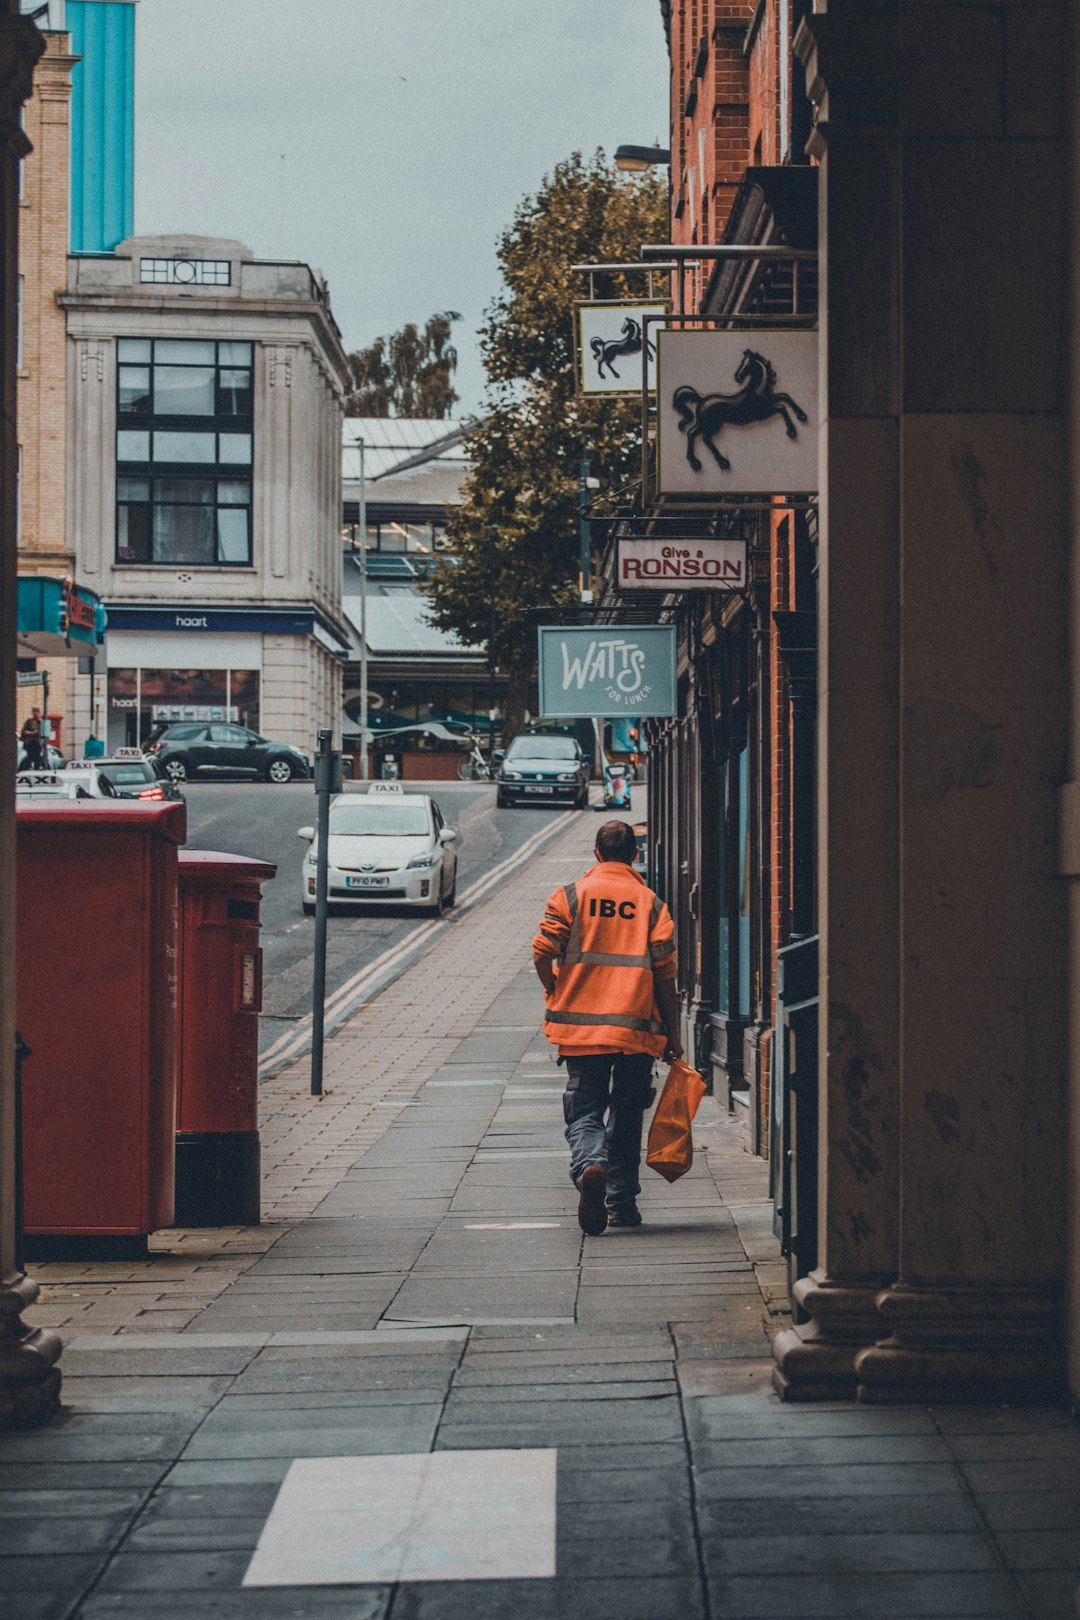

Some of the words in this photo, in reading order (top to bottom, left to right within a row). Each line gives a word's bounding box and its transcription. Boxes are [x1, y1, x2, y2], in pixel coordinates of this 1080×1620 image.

[661, 546, 690, 558] Give
[696, 549, 704, 558] a
[622, 558, 742, 579] RONSON
[175, 614, 208, 627] haart
[561, 640, 645, 692] WATTS
[604, 685, 622, 702] FOR
[624, 685, 652, 705] LUNCH
[17, 776, 57, 784] AXI
[589, 898, 636, 920] IBC
